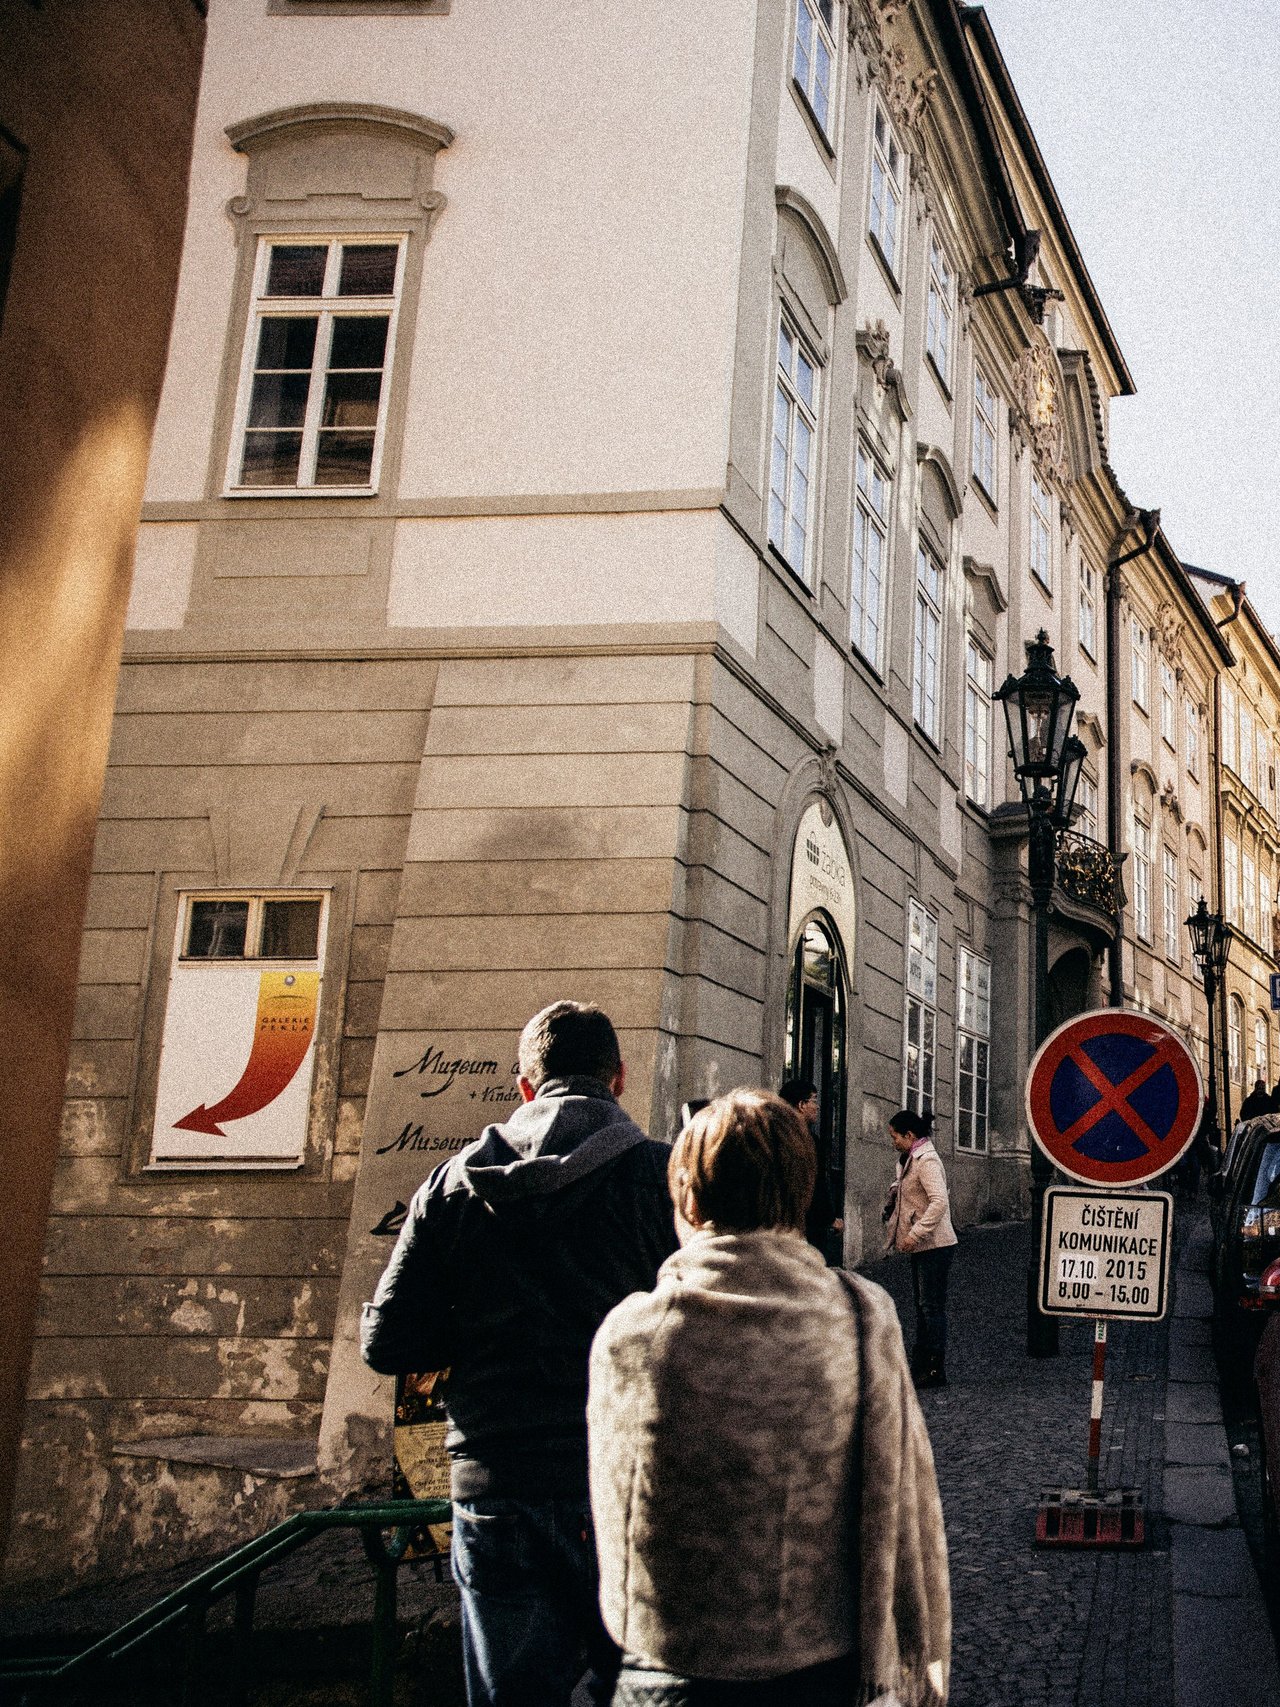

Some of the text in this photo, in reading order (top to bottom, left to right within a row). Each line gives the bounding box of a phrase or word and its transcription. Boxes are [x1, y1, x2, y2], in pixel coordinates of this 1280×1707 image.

[392, 1045, 499, 1098] Muzeum
[1082, 1204, 1140, 1230] ČIŠTĚNÍ
[1058, 1231, 1158, 1256] KOMUNIKACE
[1061, 1258, 1148, 1280] 17.10. 2015
[1058, 1281, 1090, 1300] 8,00
[1110, 1284, 1149, 1304] 15,00
